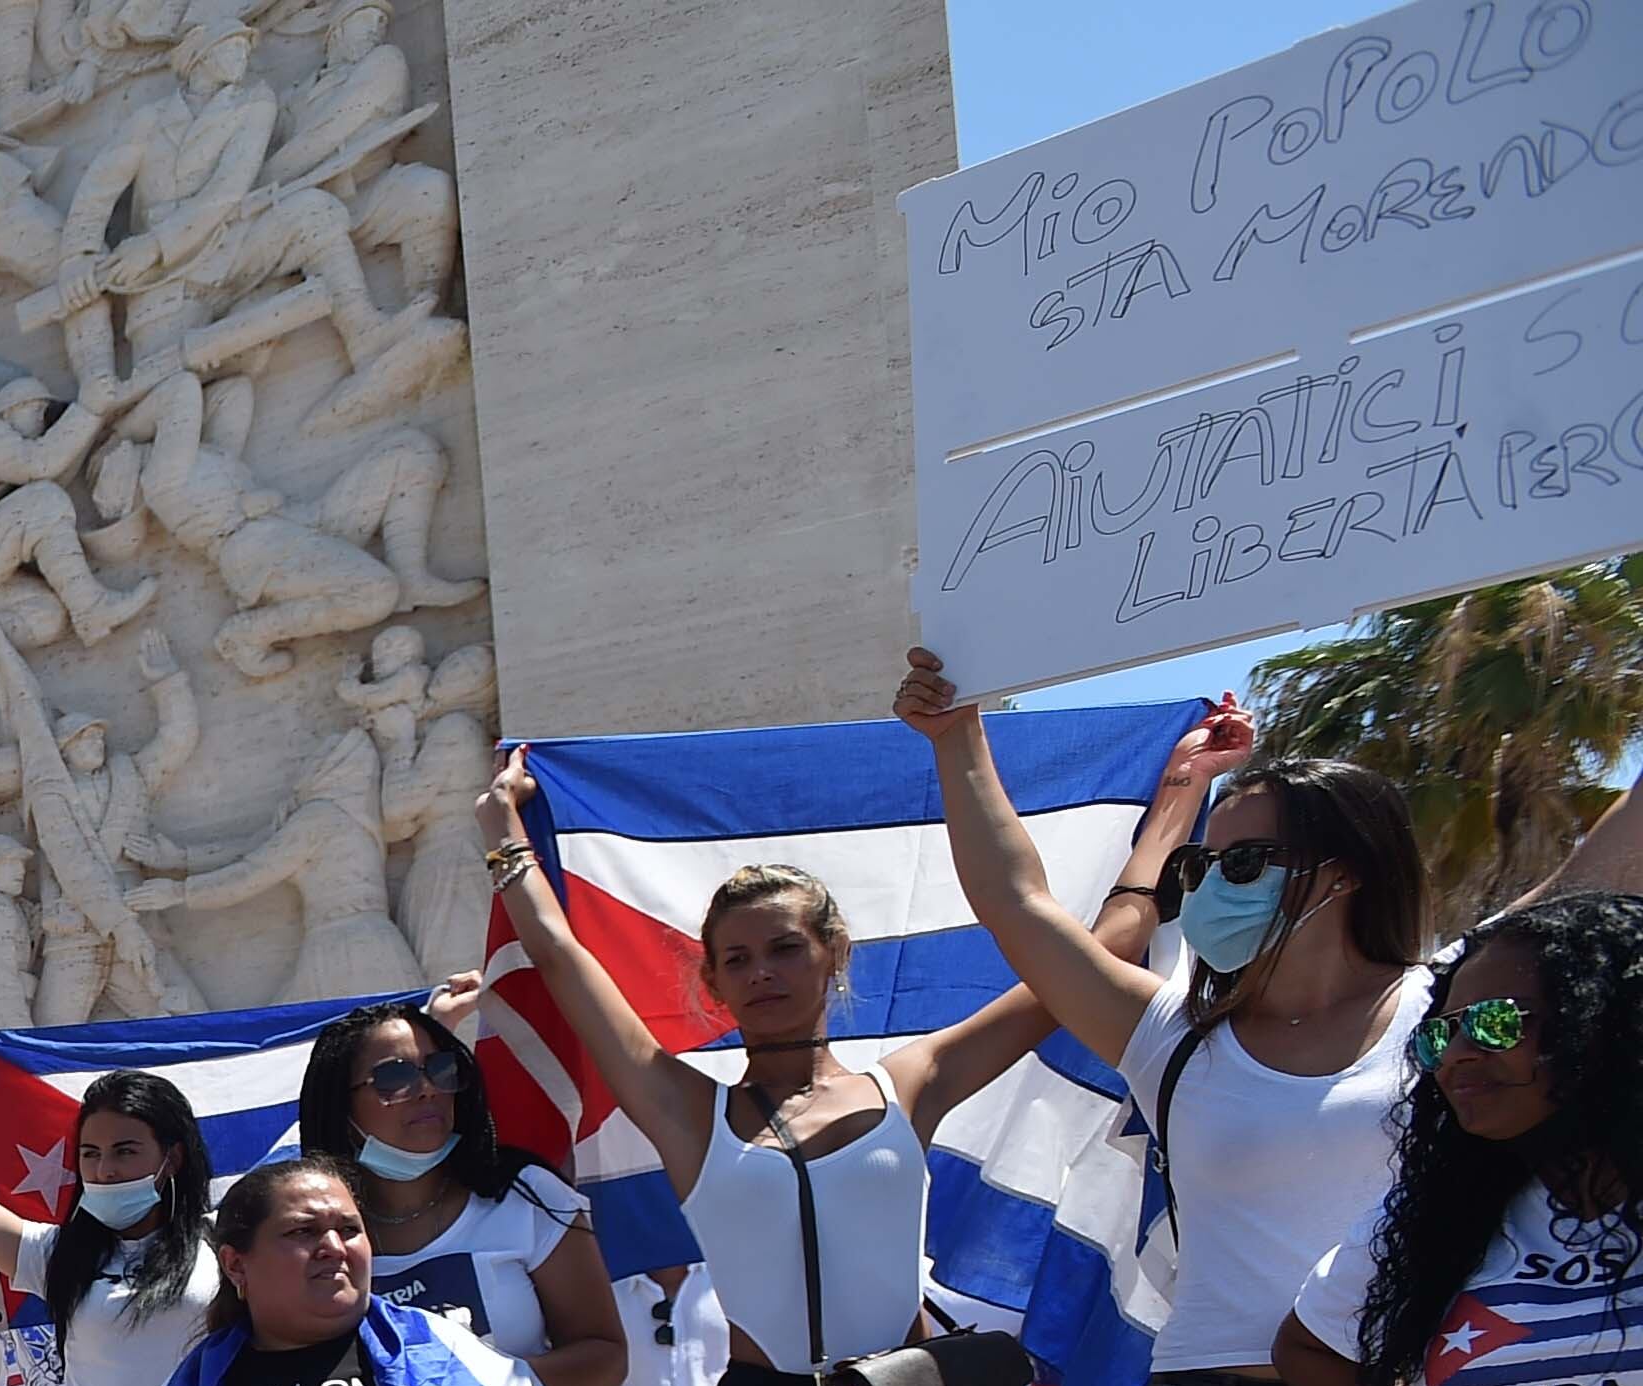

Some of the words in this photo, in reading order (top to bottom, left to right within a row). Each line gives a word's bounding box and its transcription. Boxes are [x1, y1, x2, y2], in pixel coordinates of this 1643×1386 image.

[1029, 238, 1191, 351] STA
[1514, 1249, 1631, 1286] SOS
[381, 1279, 427, 1304] TRIA
